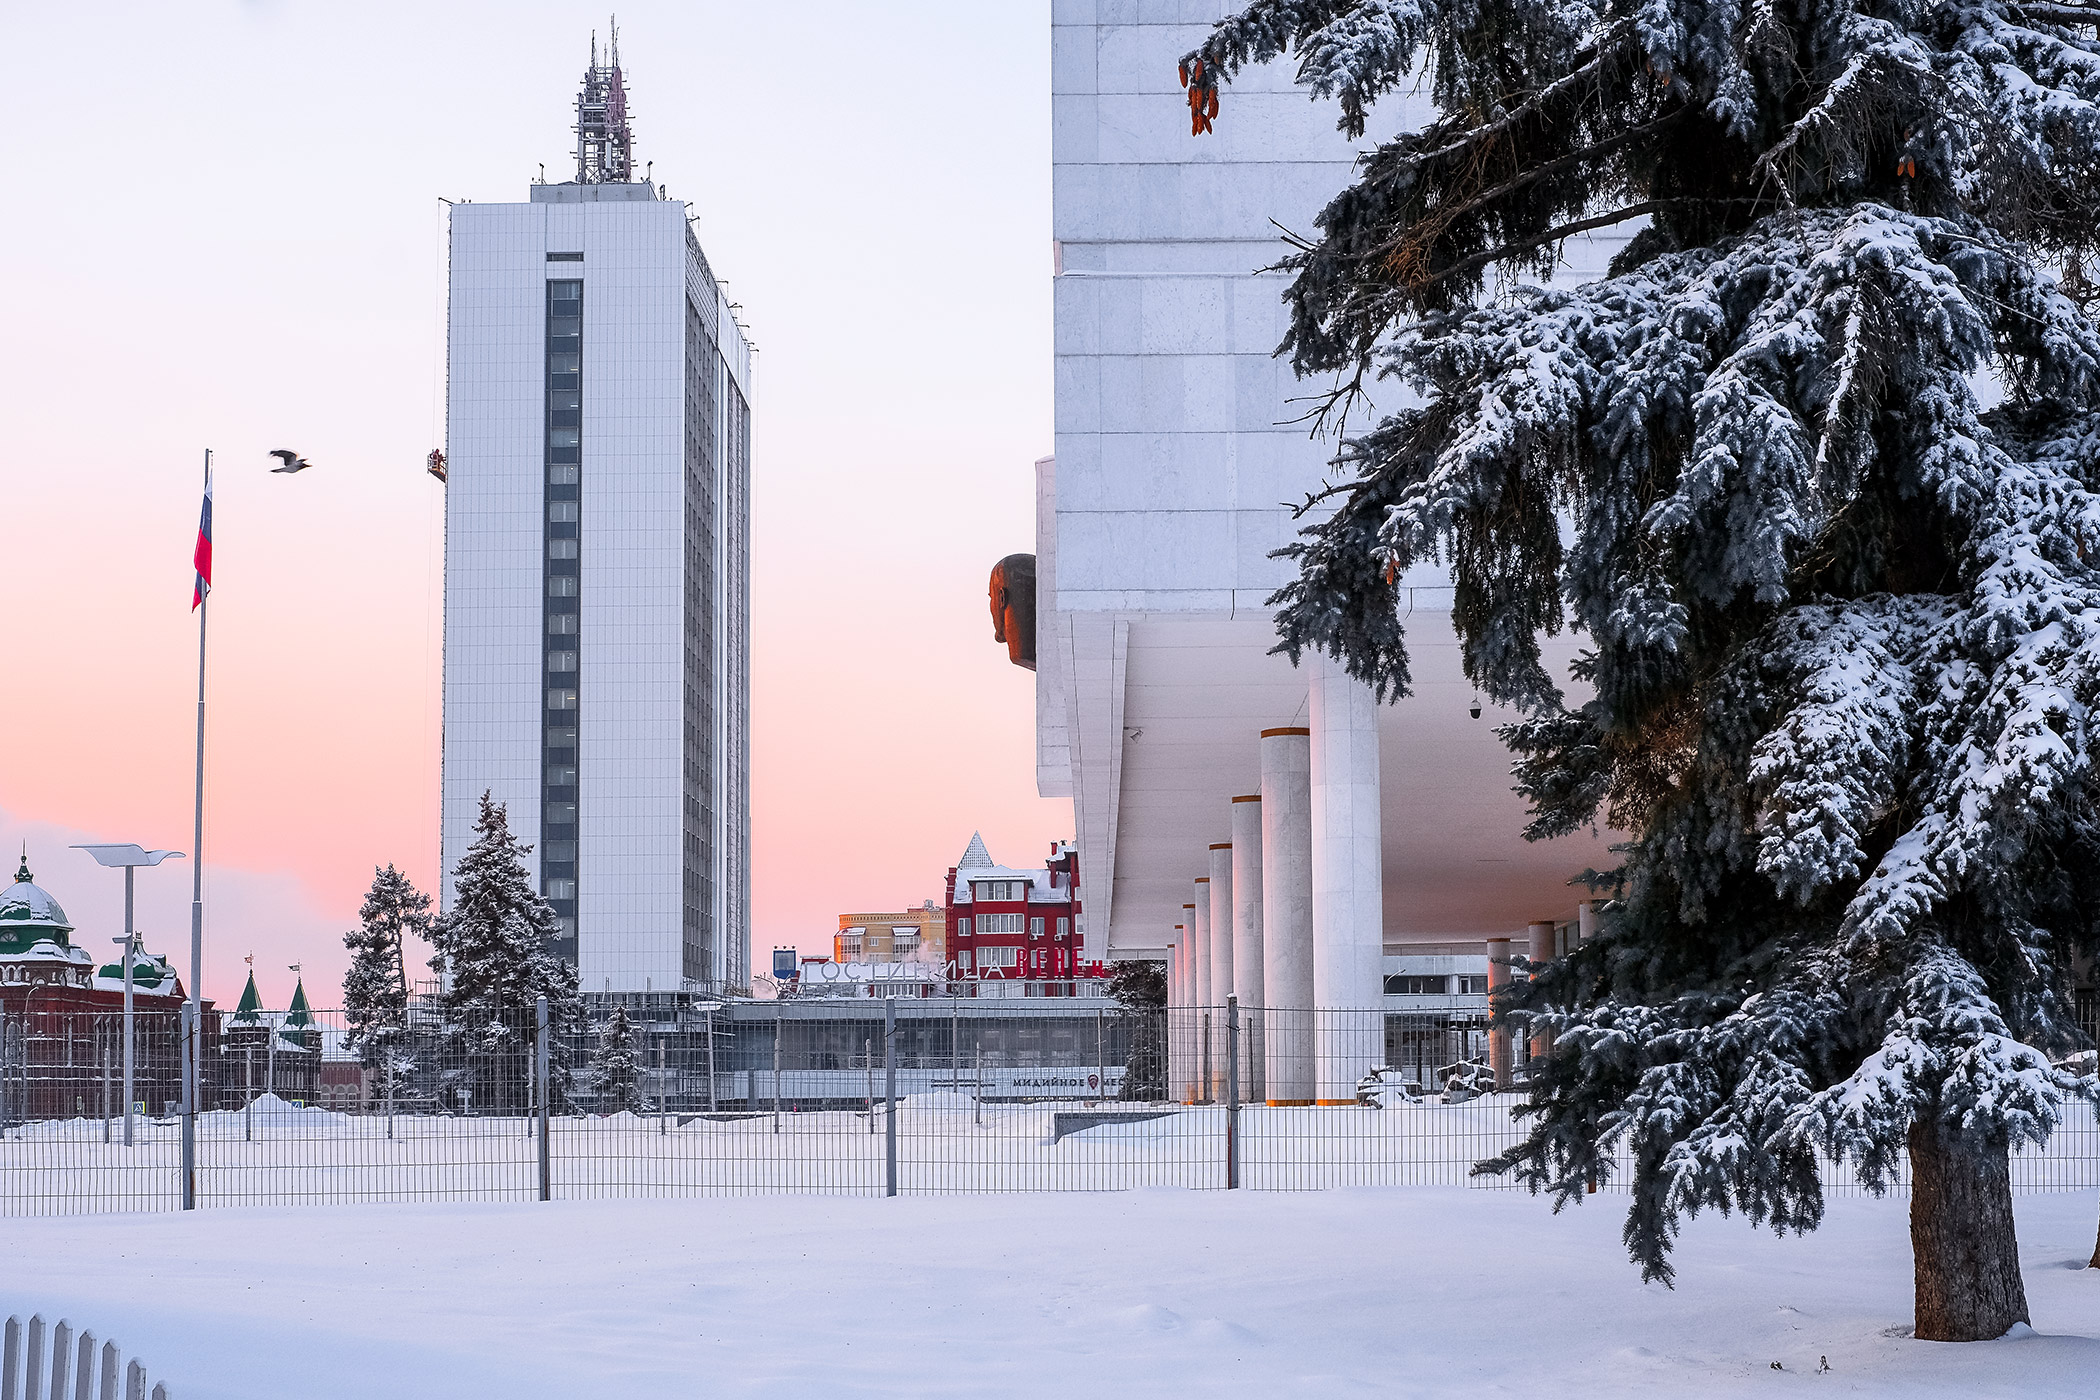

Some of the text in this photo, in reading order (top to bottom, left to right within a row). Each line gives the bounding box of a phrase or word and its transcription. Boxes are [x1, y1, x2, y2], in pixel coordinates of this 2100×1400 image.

[804, 959, 1005, 982] ГОСТИНИЦА
[1013, 1076, 1125, 1087] МИДИЙНОЕ МЕС
